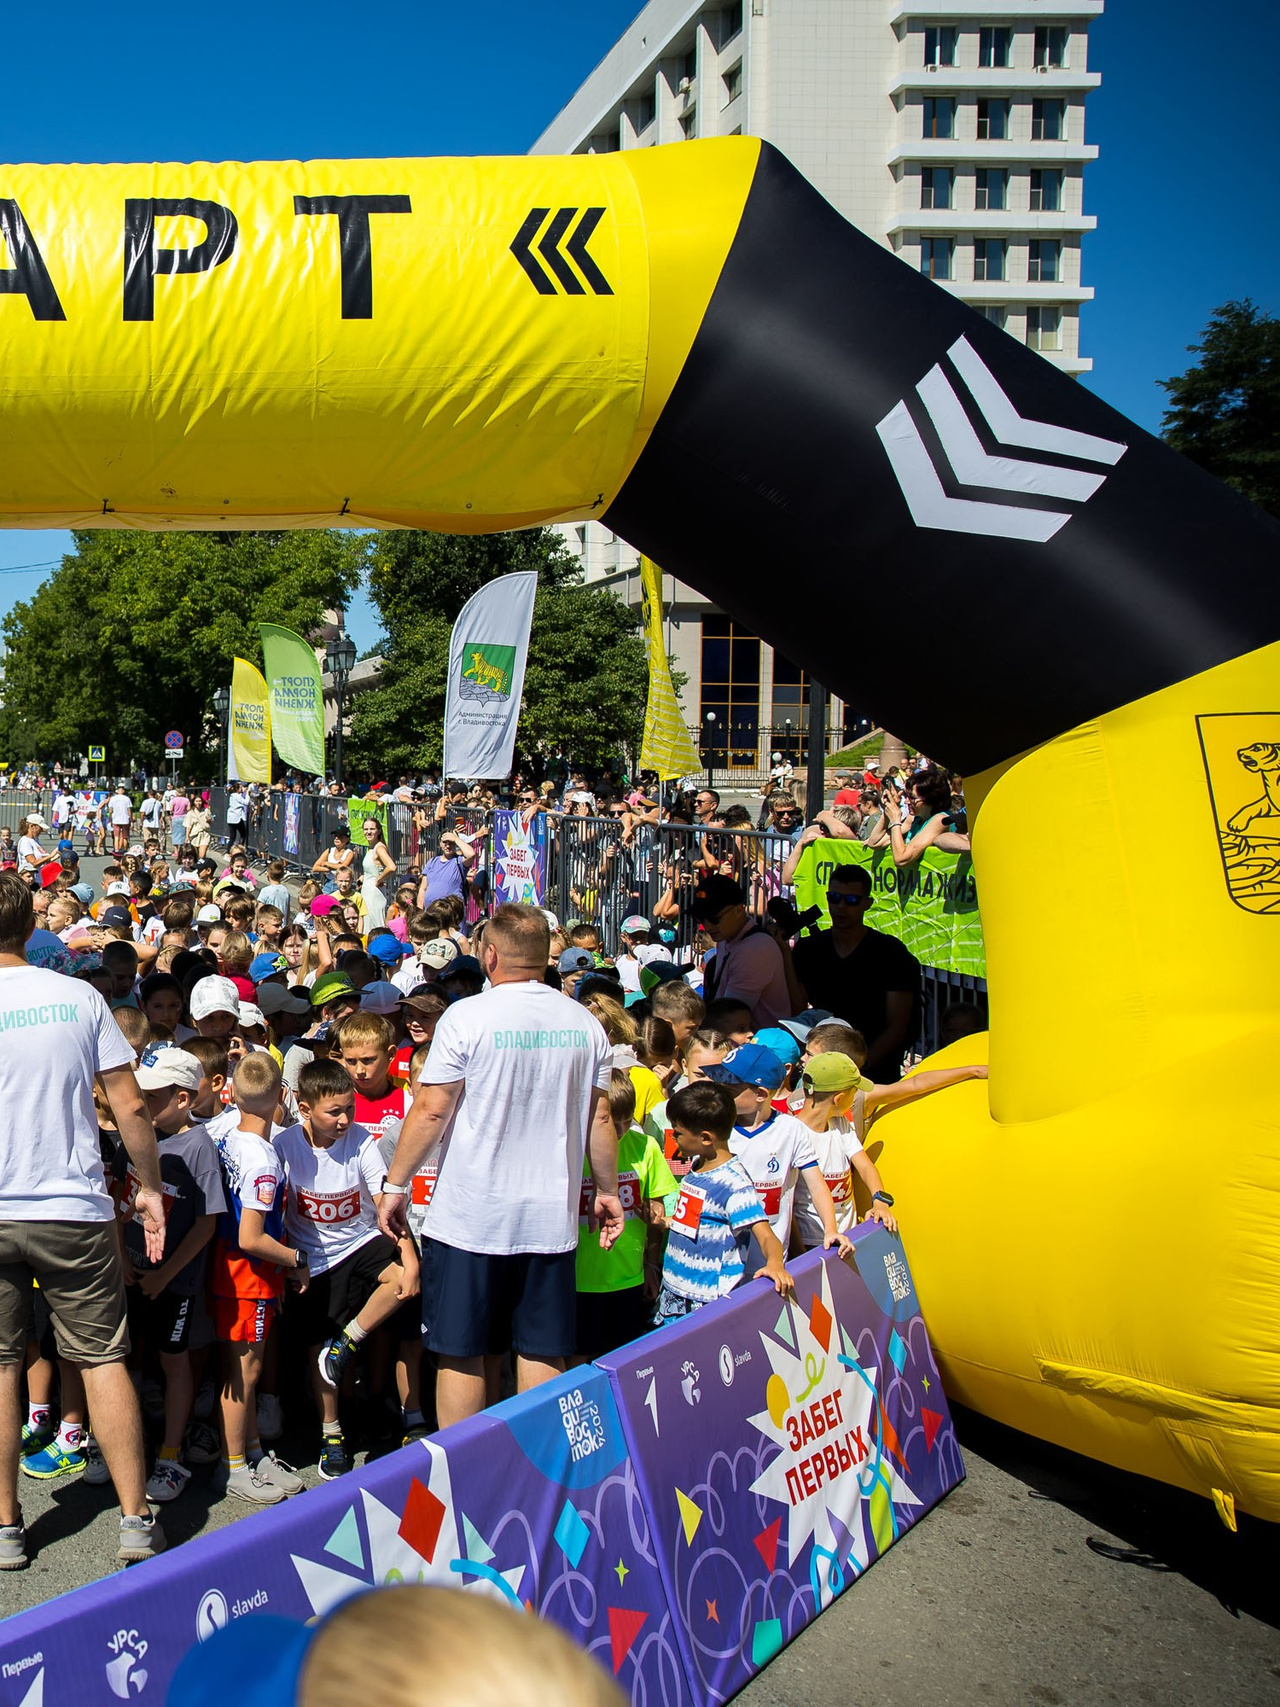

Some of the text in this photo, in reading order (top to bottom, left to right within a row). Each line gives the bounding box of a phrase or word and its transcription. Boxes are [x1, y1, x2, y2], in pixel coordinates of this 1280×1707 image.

[459, 711, 508, 720] Администрация
[463, 718, 506, 727] Владивостока
[510, 848, 527, 863] ЗАБЕГ
[506, 863, 530, 880] ПЕРВЫХ
[873, 866, 976, 903] НОРМА ЖИЗ
[494, 1029, 588, 1051] ВЛАДИВОСТОК
[300, 1188, 355, 1199] ЗАБЕГ ПЕРВЫХ
[303, 1199, 354, 1221] 206
[170, 1299, 189, 1342] TO WIN
[255, 1299, 266, 1342] АСТИОН
[734, 1350, 752, 1367] slavda
[589, 1404, 607, 1448] 2024
[786, 1388, 844, 1453] ЗАБЕГ
[784, 1425, 870, 1507] ПЕРВЫХ
[231, 1589, 270, 1619] slavda
[107, 1629, 149, 1660] УРСА
[1, 1651, 44, 1679] Первые
